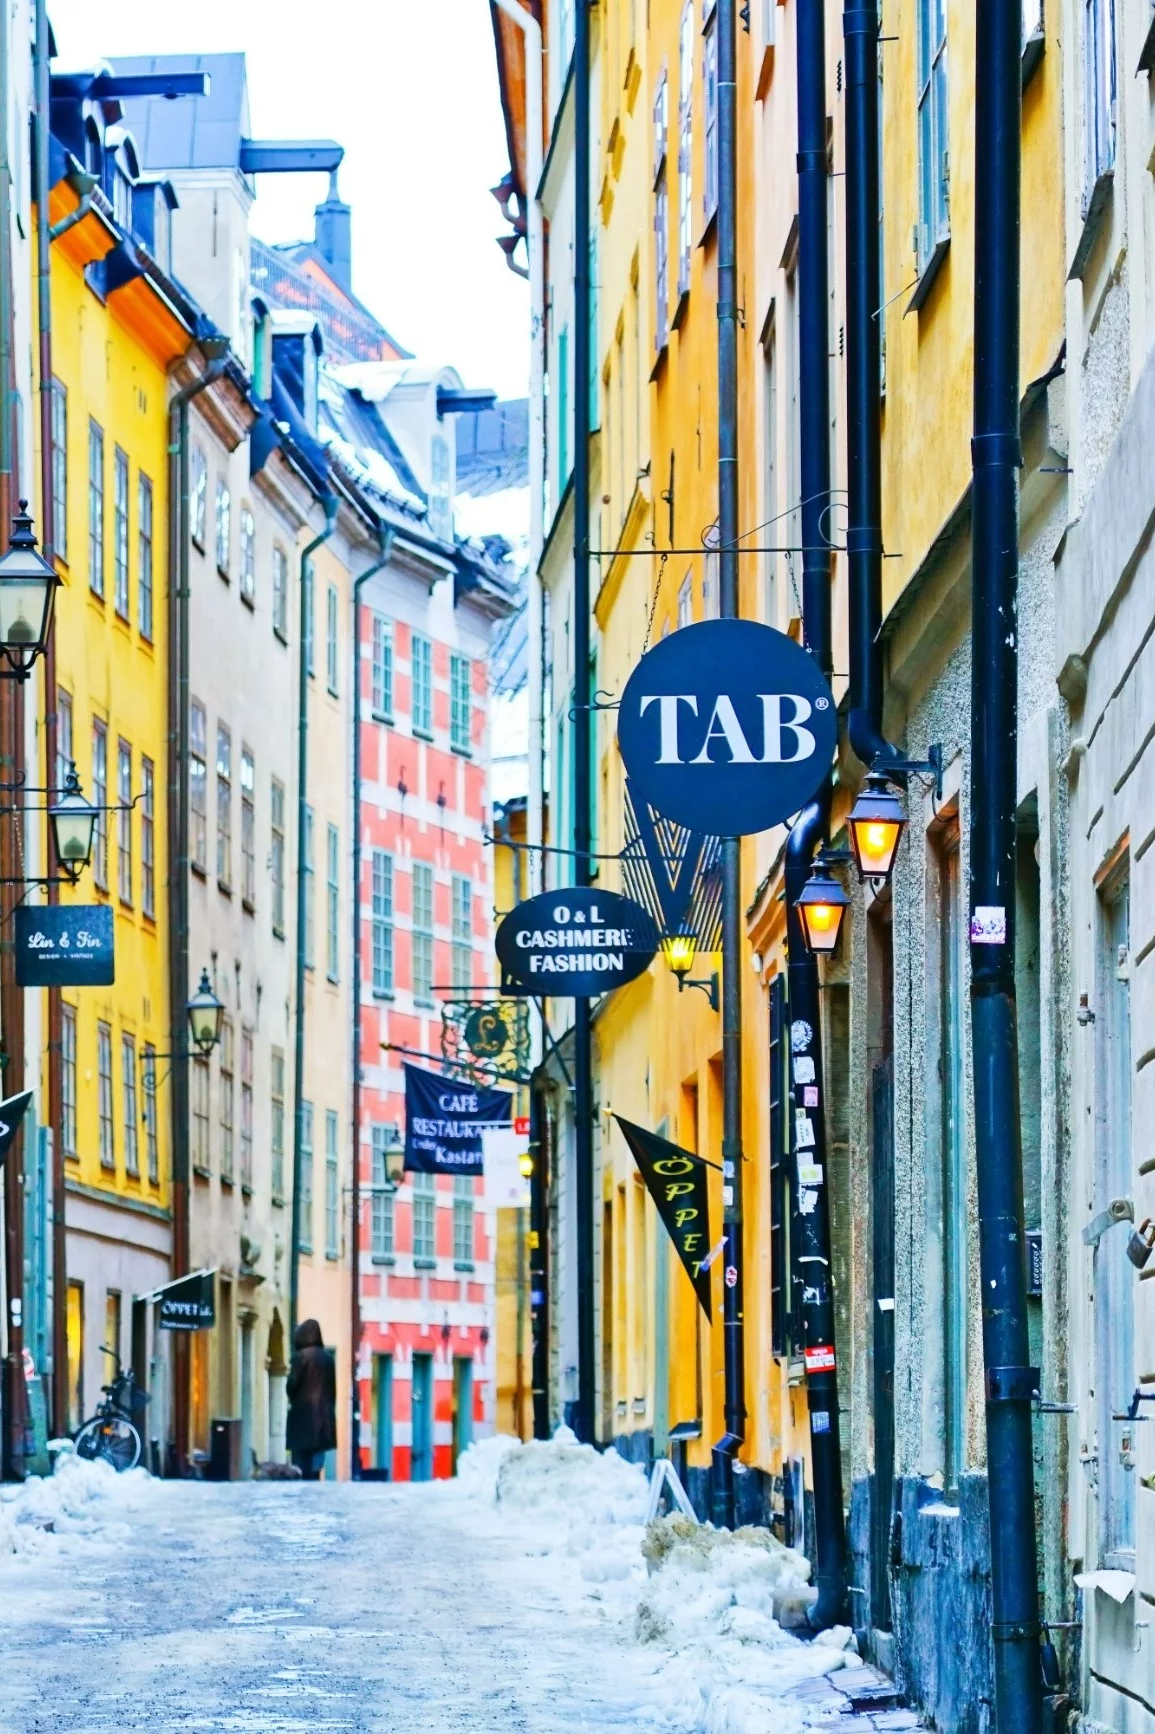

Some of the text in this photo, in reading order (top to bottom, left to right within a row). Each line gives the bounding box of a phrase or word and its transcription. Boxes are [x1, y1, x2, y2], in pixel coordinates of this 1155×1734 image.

[553, 905, 605, 924] O & L
[28, 931, 55, 949] Lin
[59, 932, 70, 949] &
[530, 953, 624, 973] FASHION
[438, 1094, 479, 1112] CAFÉ
[652, 1155, 707, 1279] ÖPPET
